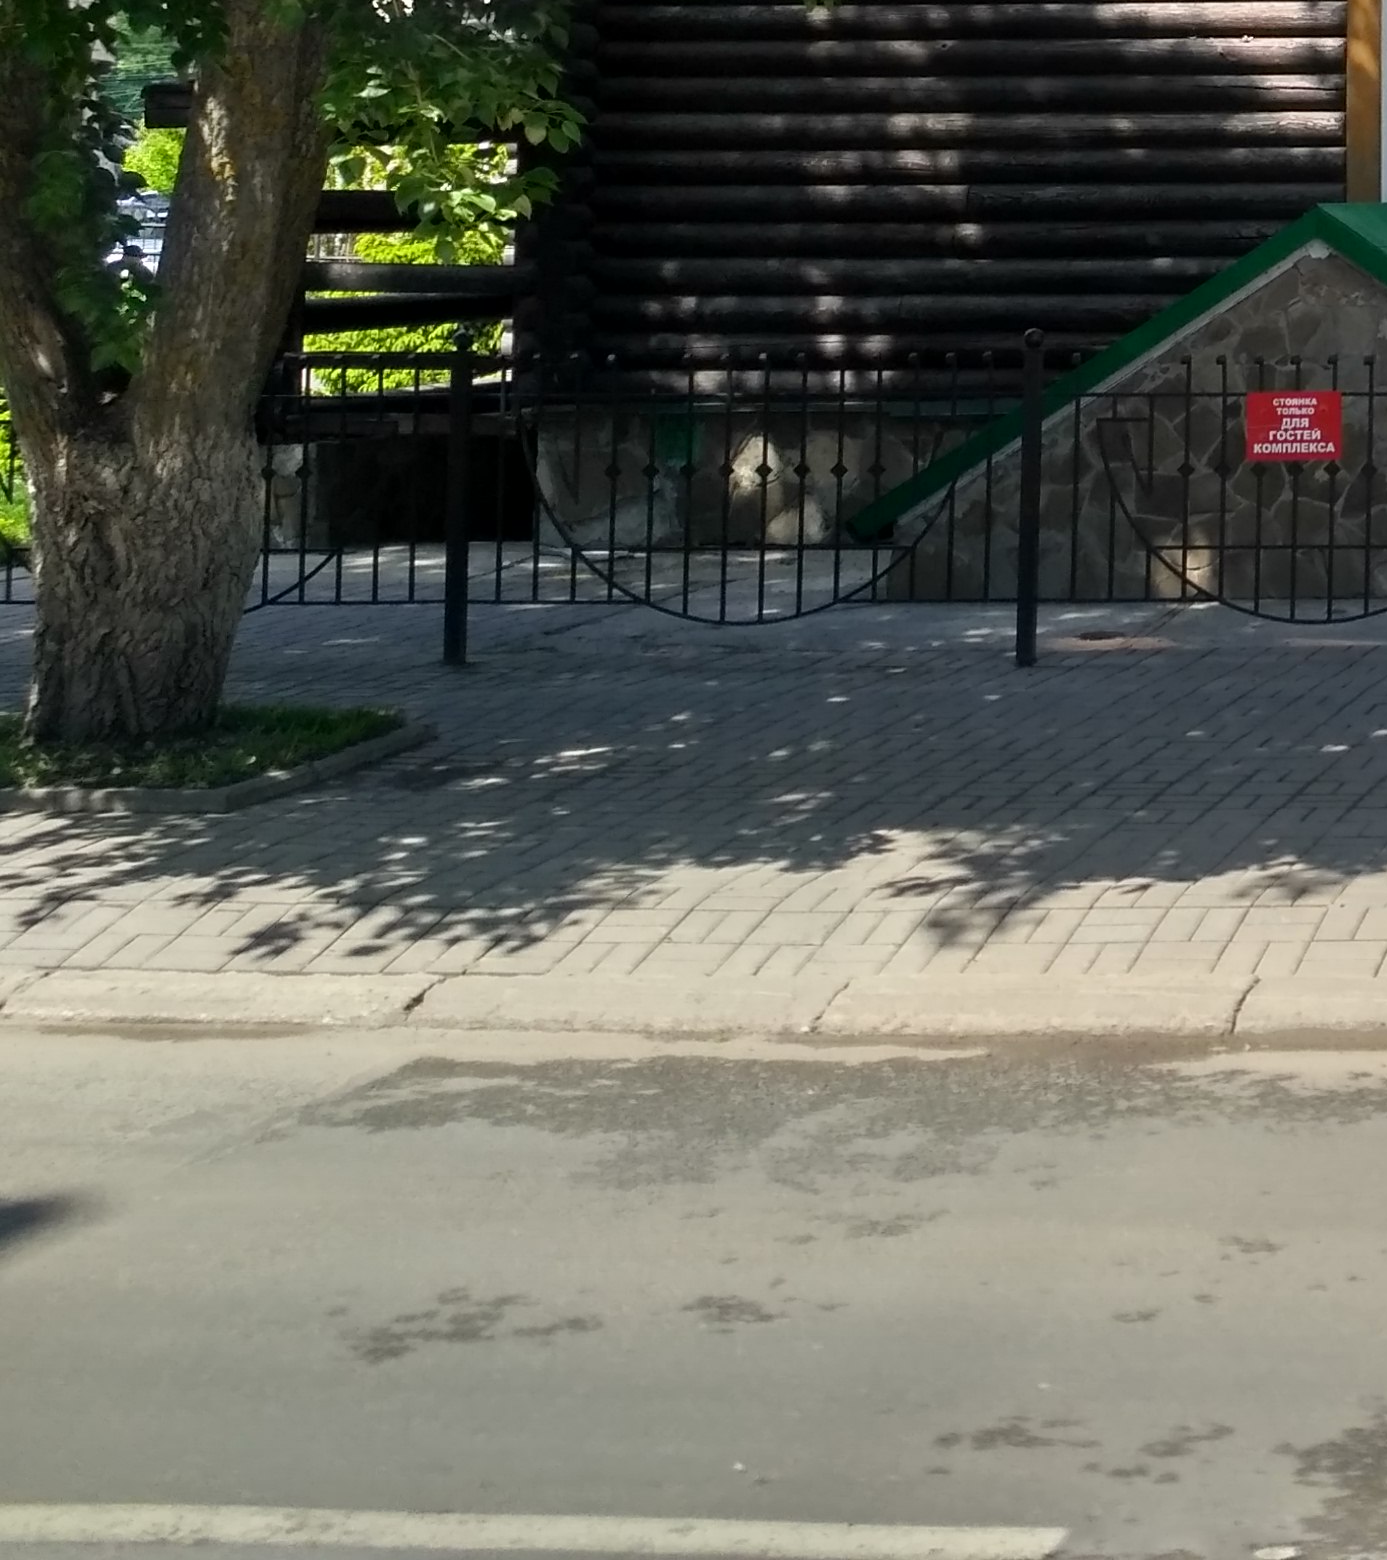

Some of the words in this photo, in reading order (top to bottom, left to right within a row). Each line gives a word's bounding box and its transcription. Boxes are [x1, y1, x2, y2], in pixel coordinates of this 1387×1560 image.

[1272, 398, 1318, 406] СТОЯНКА
[1276, 407, 1316, 416] ТОЛЬКО
[1281, 417, 1310, 430] ДЛЯ
[1268, 428, 1321, 441] ГОСТЕЙ
[1253, 442, 1336, 454] КОМПЛЕКСА
